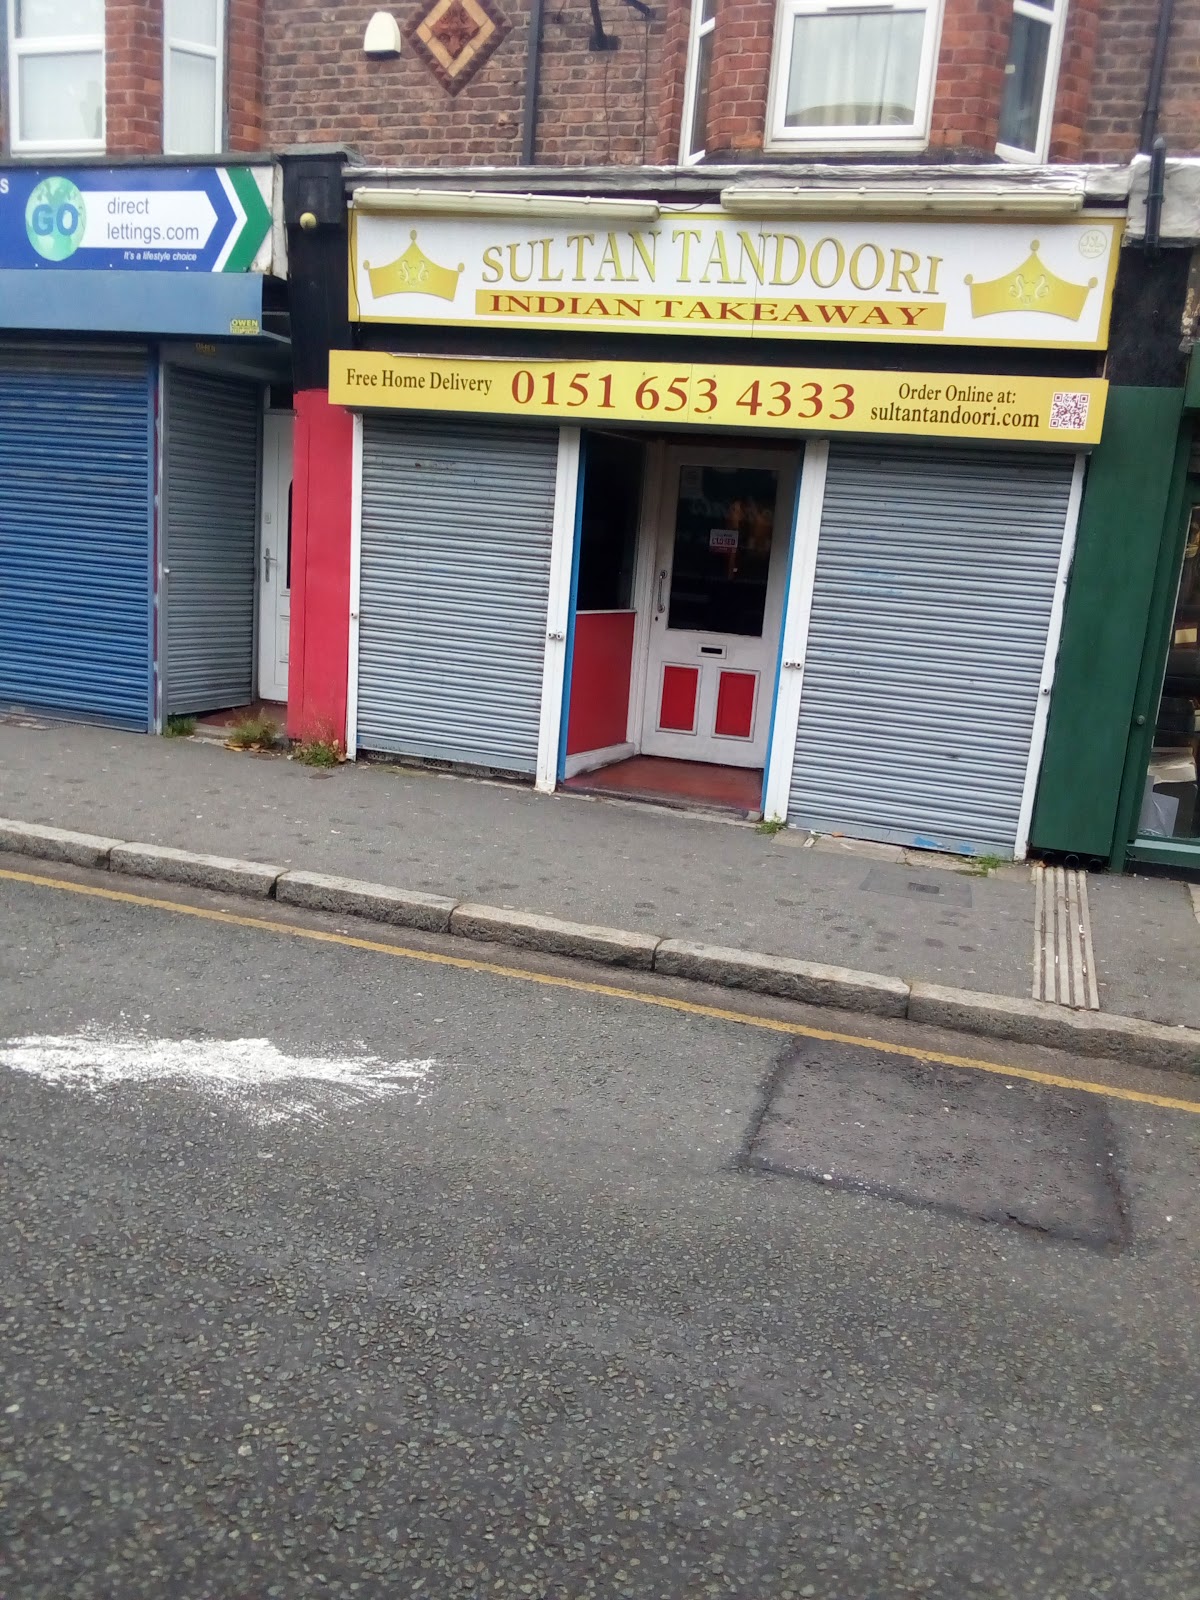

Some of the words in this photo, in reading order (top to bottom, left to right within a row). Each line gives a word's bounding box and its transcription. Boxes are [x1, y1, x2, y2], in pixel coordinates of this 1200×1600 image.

[107, 197, 149, 214] direct
[31, 203, 79, 236] GO
[107, 222, 199, 244] lettings.com
[123, 250, 135, 260] It's
[136, 252, 142, 260] a
[142, 250, 171, 262] lifestyle
[172, 251, 197, 261] choice
[481, 230, 661, 283] SULTAN
[671, 229, 943, 295] TANDOORI
[489, 294, 643, 317] INDIAN
[655, 300, 929, 326] TAKEAWAY
[231, 319, 258, 327] OWEN
[346, 368, 378, 387] Free
[382, 369, 426, 390] Home
[430, 371, 492, 395] Delivery
[511, 369, 616, 409] 0151
[634, 375, 719, 413] 653
[735, 379, 856, 420] 4333
[898, 382, 941, 401] Order
[945, 384, 993, 403] Online
[996, 388, 1016, 405] at:
[870, 403, 1040, 428] sultantandoori.com
